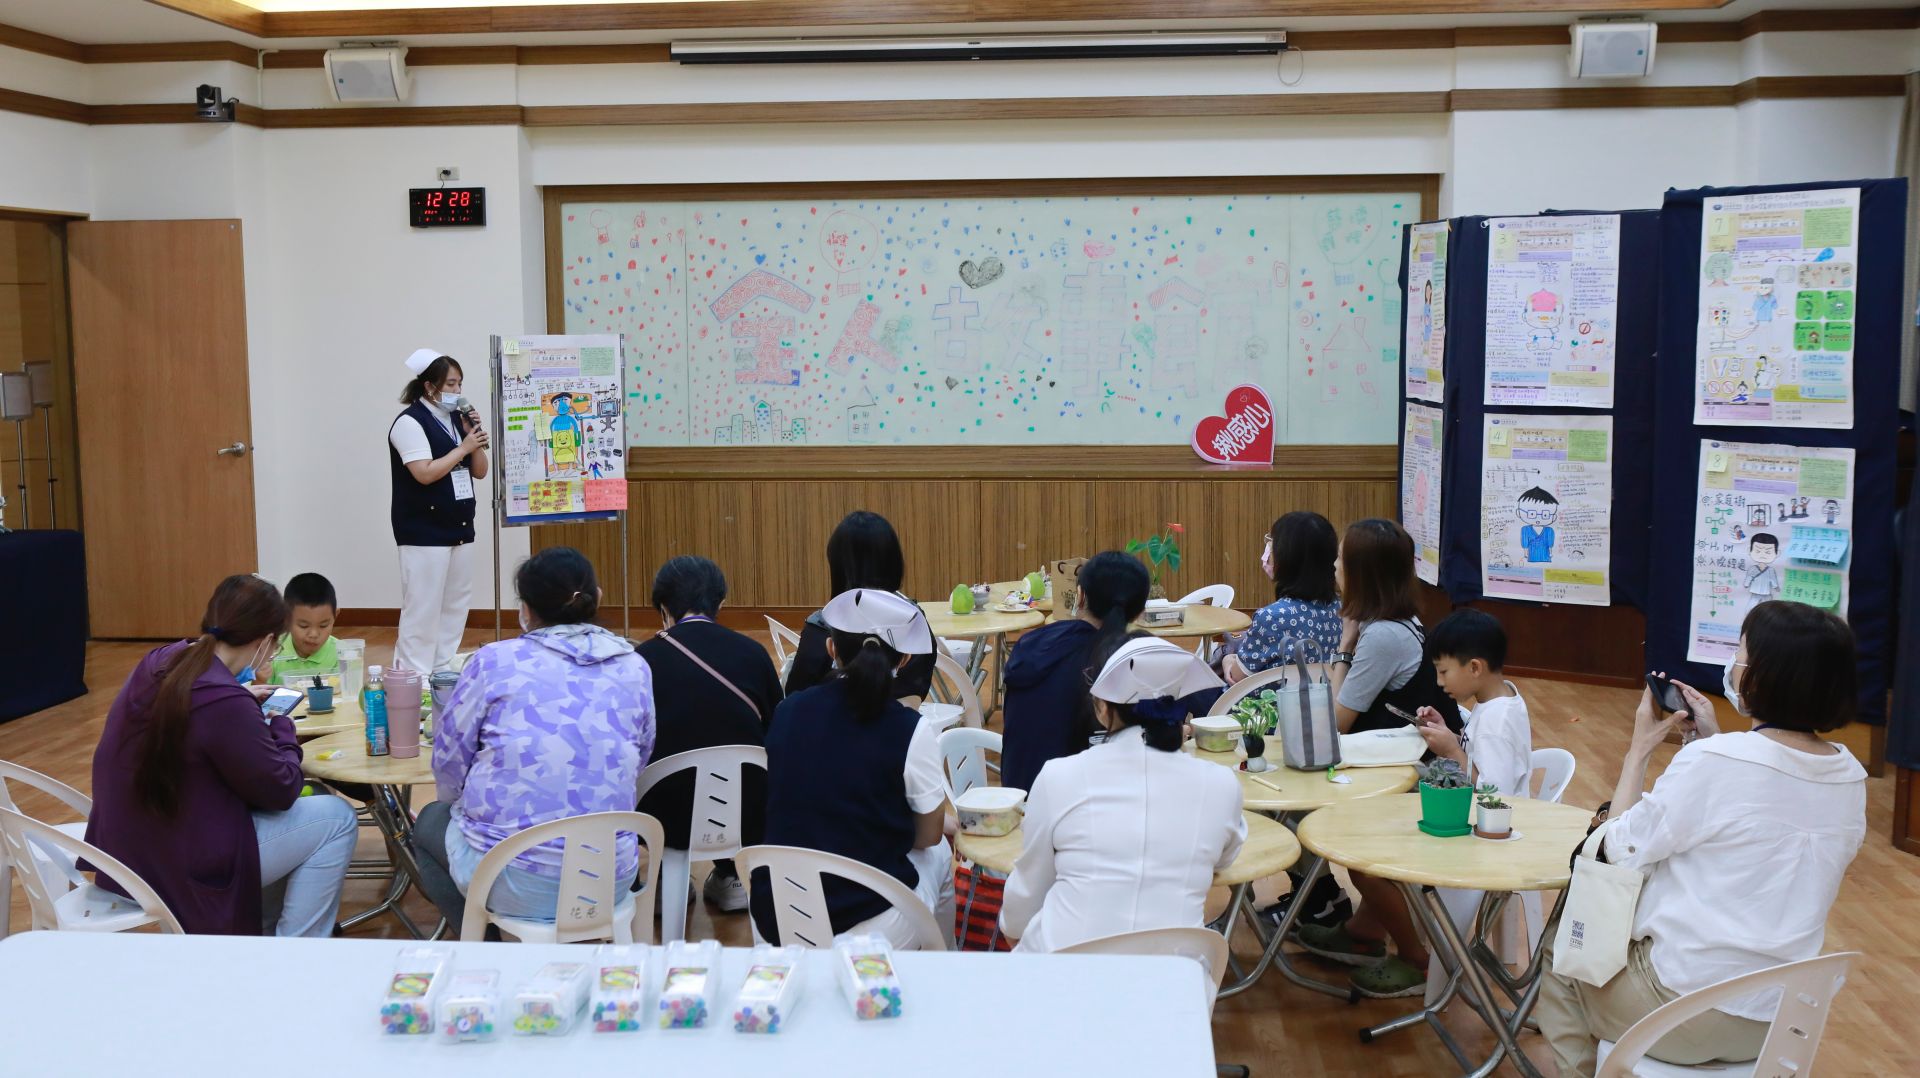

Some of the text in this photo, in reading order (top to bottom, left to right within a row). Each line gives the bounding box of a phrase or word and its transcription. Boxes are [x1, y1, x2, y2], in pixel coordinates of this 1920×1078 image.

[427, 191, 470, 207] 12 28
[1211, 402, 1271, 462] 揪感心
